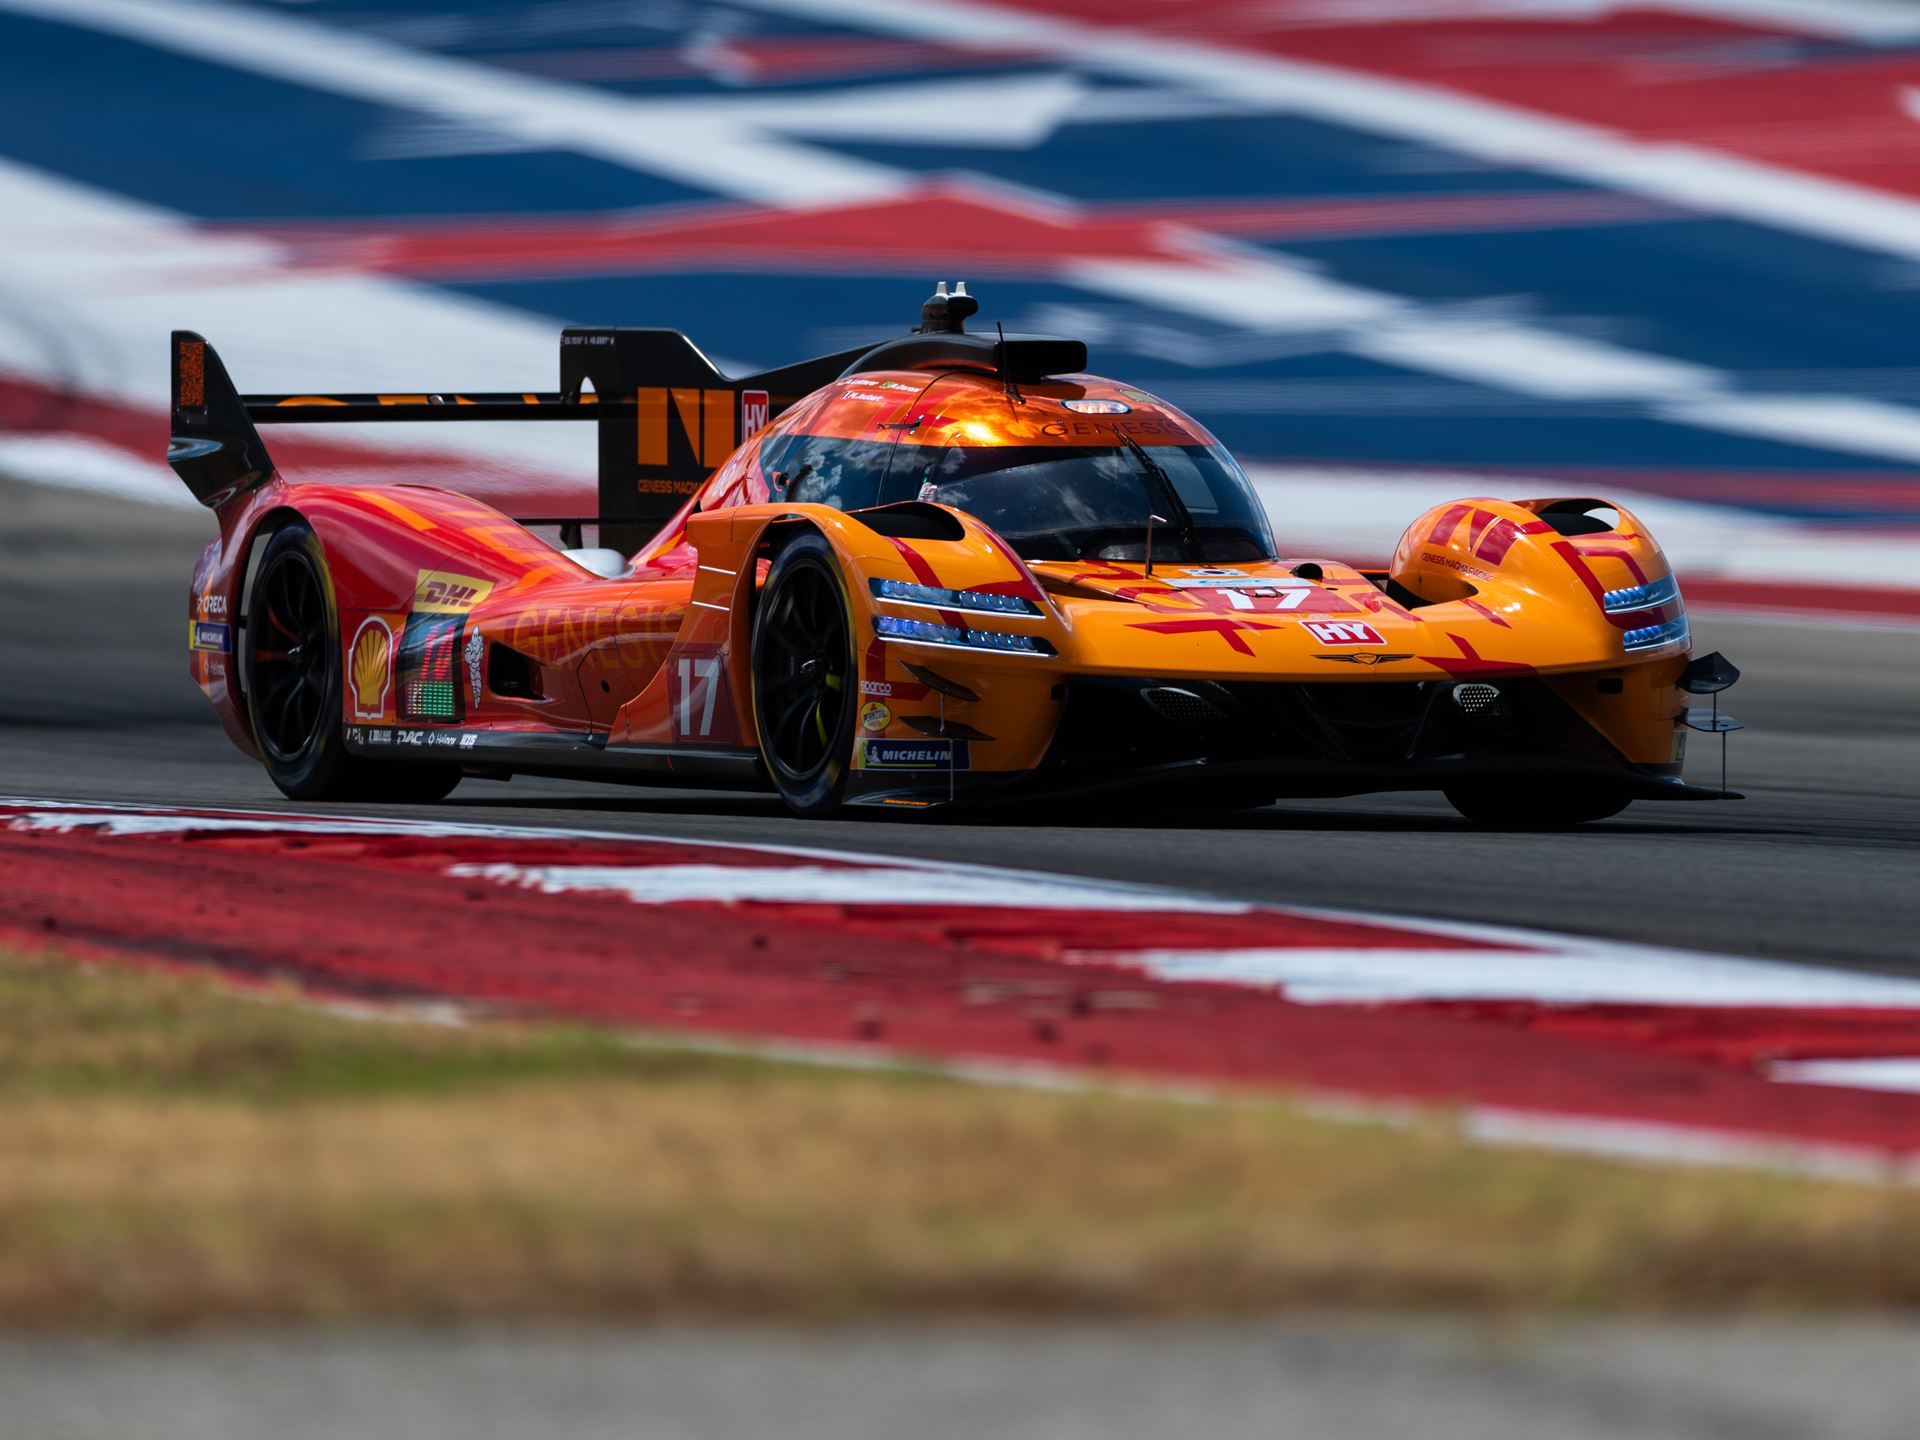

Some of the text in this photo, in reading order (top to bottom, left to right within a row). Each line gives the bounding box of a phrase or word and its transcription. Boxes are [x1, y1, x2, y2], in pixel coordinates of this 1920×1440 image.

[744, 404, 766, 442] HY
[1041, 421, 1189, 437] GENESIS
[637, 479, 672, 493] GENESIS
[423, 580, 478, 607] DHL
[1215, 588, 1312, 610] 17
[203, 594, 228, 614] ORECA
[201, 631, 224, 644] MICHELIN
[1307, 623, 1370, 641] HY
[677, 658, 720, 736] 17
[860, 681, 892, 695] sparco
[882, 750, 952, 761] MICHELIN
